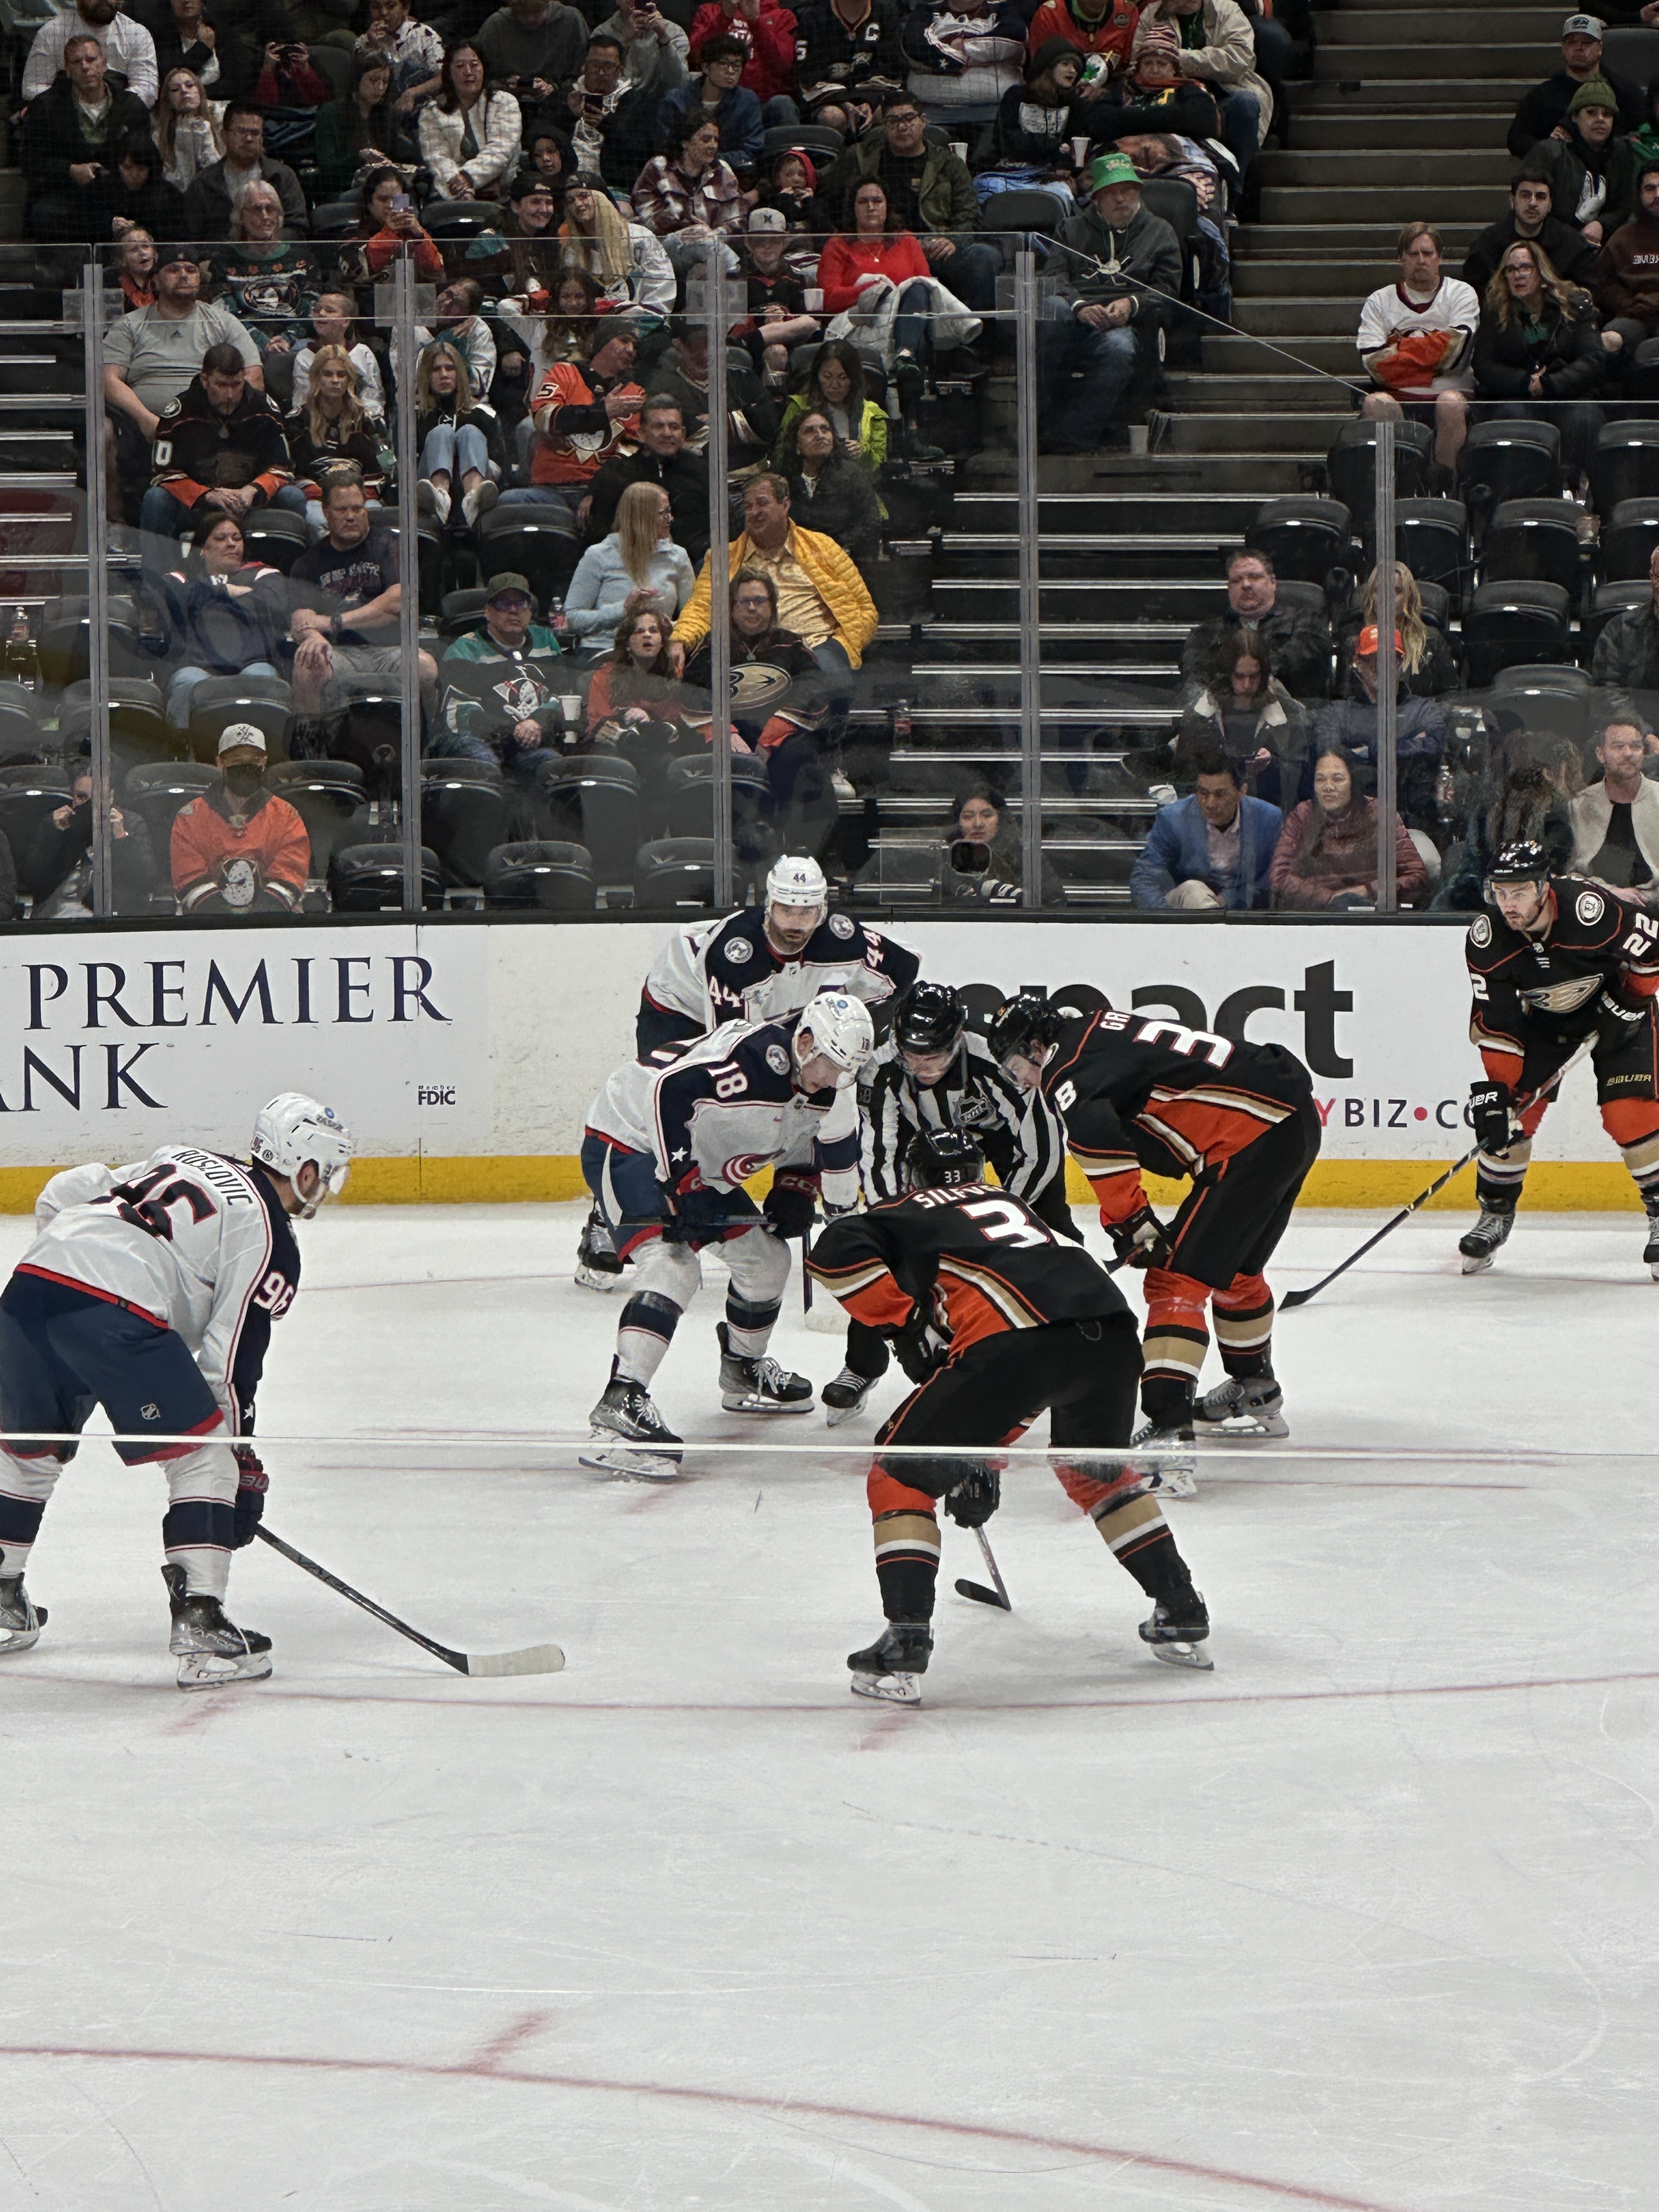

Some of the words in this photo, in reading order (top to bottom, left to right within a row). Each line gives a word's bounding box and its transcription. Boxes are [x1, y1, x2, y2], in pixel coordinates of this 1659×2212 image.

[793, 873, 806, 883] 44
[21, 956, 453, 1030] PREMIER
[0, 1043, 169, 1112] NK
[706, 1060, 750, 1099] 18
[418, 1090, 456, 1105] FDIC
[944, 1170, 961, 1184] 33
